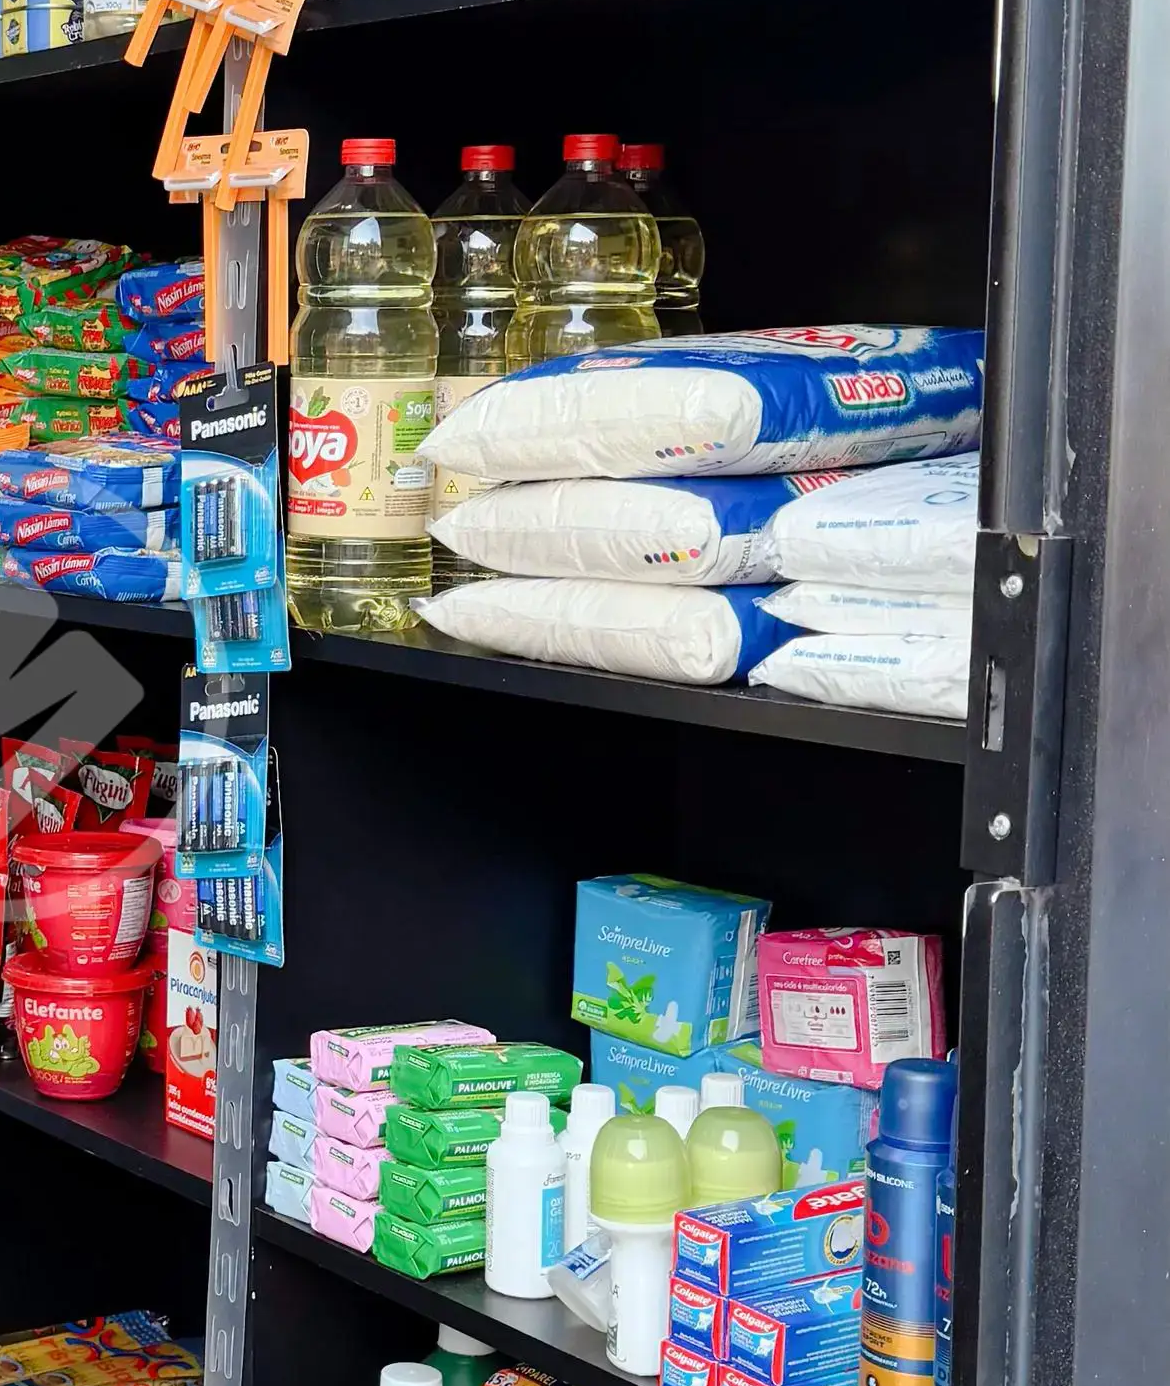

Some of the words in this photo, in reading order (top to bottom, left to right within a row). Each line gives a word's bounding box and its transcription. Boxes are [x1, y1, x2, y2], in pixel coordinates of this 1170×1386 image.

[157, 287, 184, 310] Nissin
[836, 373, 906, 404] união
[405, 400, 432, 419] Soya
[190, 405, 268, 441] Panasonic
[289, 429, 348, 470] oya
[24, 474, 48, 496] Nissin
[17, 519, 45, 540] Nissin
[45, 516, 71, 530] Lámen
[196, 494, 206, 552] Panasonic
[217, 489, 227, 549] Panasonic
[34, 561, 61, 584] Nissin
[61, 558, 91, 573] Lámen
[184, 664, 198, 679] AA
[189, 692, 261, 723] Panasonic
[82, 767, 132, 805] Fugini
[223, 772, 235, 837] Panasonic
[597, 925, 673, 958] SempreLivre
[783, 951, 824, 966] Carefree
[24, 997, 104, 1021] Elefante
[607, 1047, 678, 1077] SempreLivre
[736, 1067, 814, 1103] SempreLivre
[875, 1171, 915, 1190] SILICONE
[679, 1218, 718, 1241] Colgate
[673, 1283, 712, 1306] Colgate
[866, 1277, 887, 1300] 72h
[733, 1308, 775, 1333] Colgate
[665, 1347, 705, 1370] Colgate
